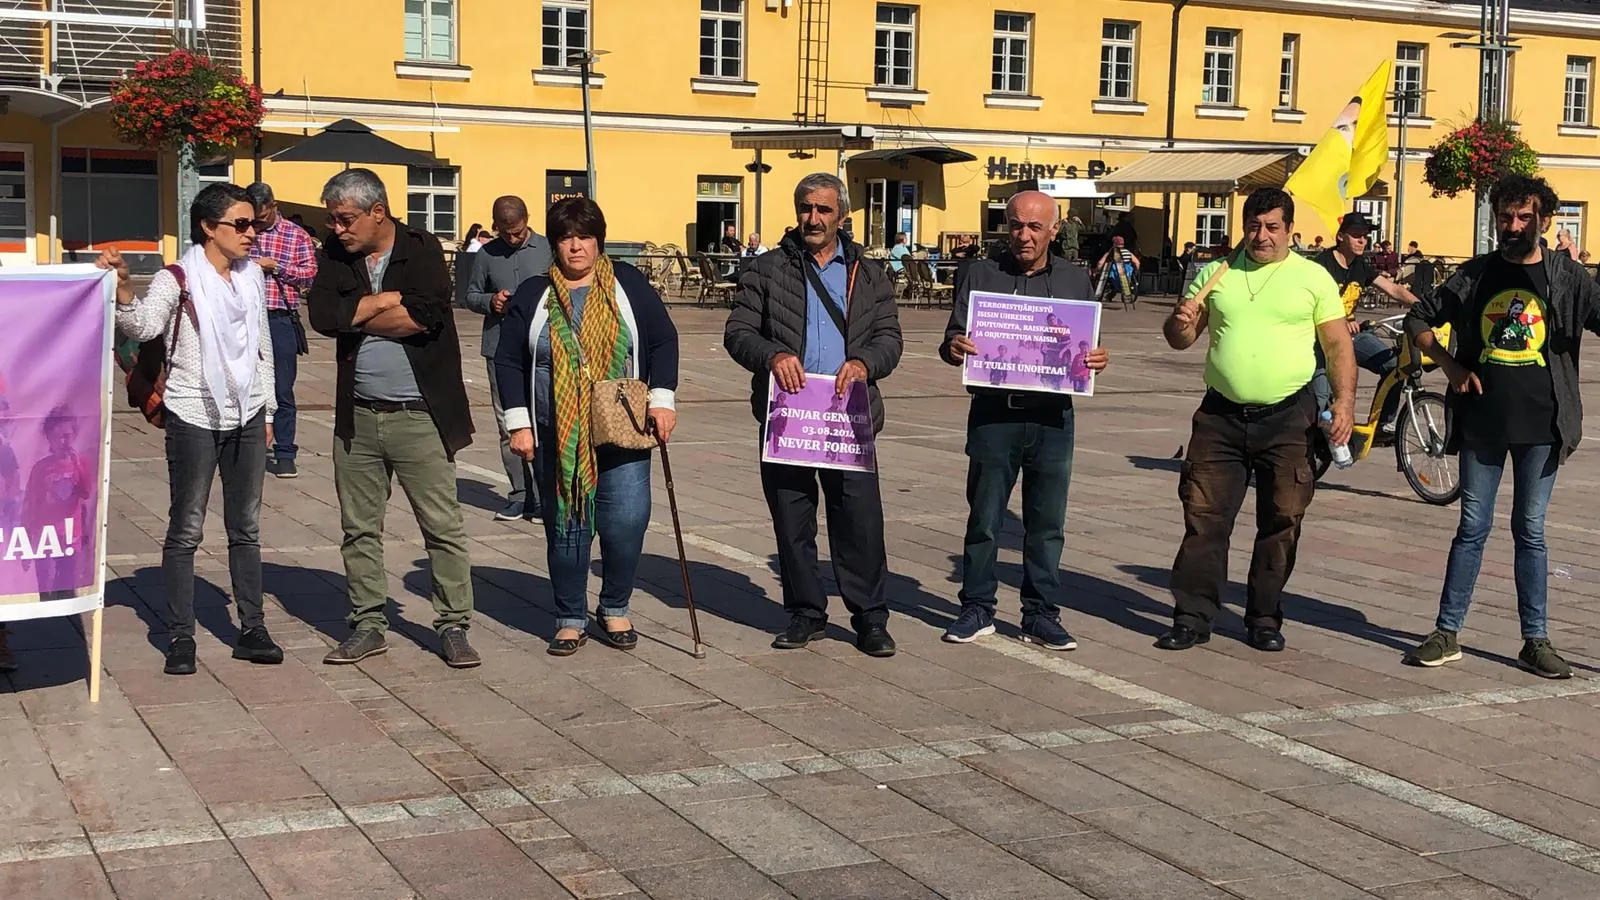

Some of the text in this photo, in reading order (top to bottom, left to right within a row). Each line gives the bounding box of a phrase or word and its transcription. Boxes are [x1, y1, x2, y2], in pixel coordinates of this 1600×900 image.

[987, 156, 1078, 180] HENRY'S
[975, 330, 983, 338] JA
[1033, 335, 1057, 343] NAISIA
[973, 360, 1067, 376] EI TULISI UNOHTAA!
[780, 407, 820, 421] SINJAR
[802, 426, 855, 439] 03.08.2014
[778, 437, 820, 451] NEVER
